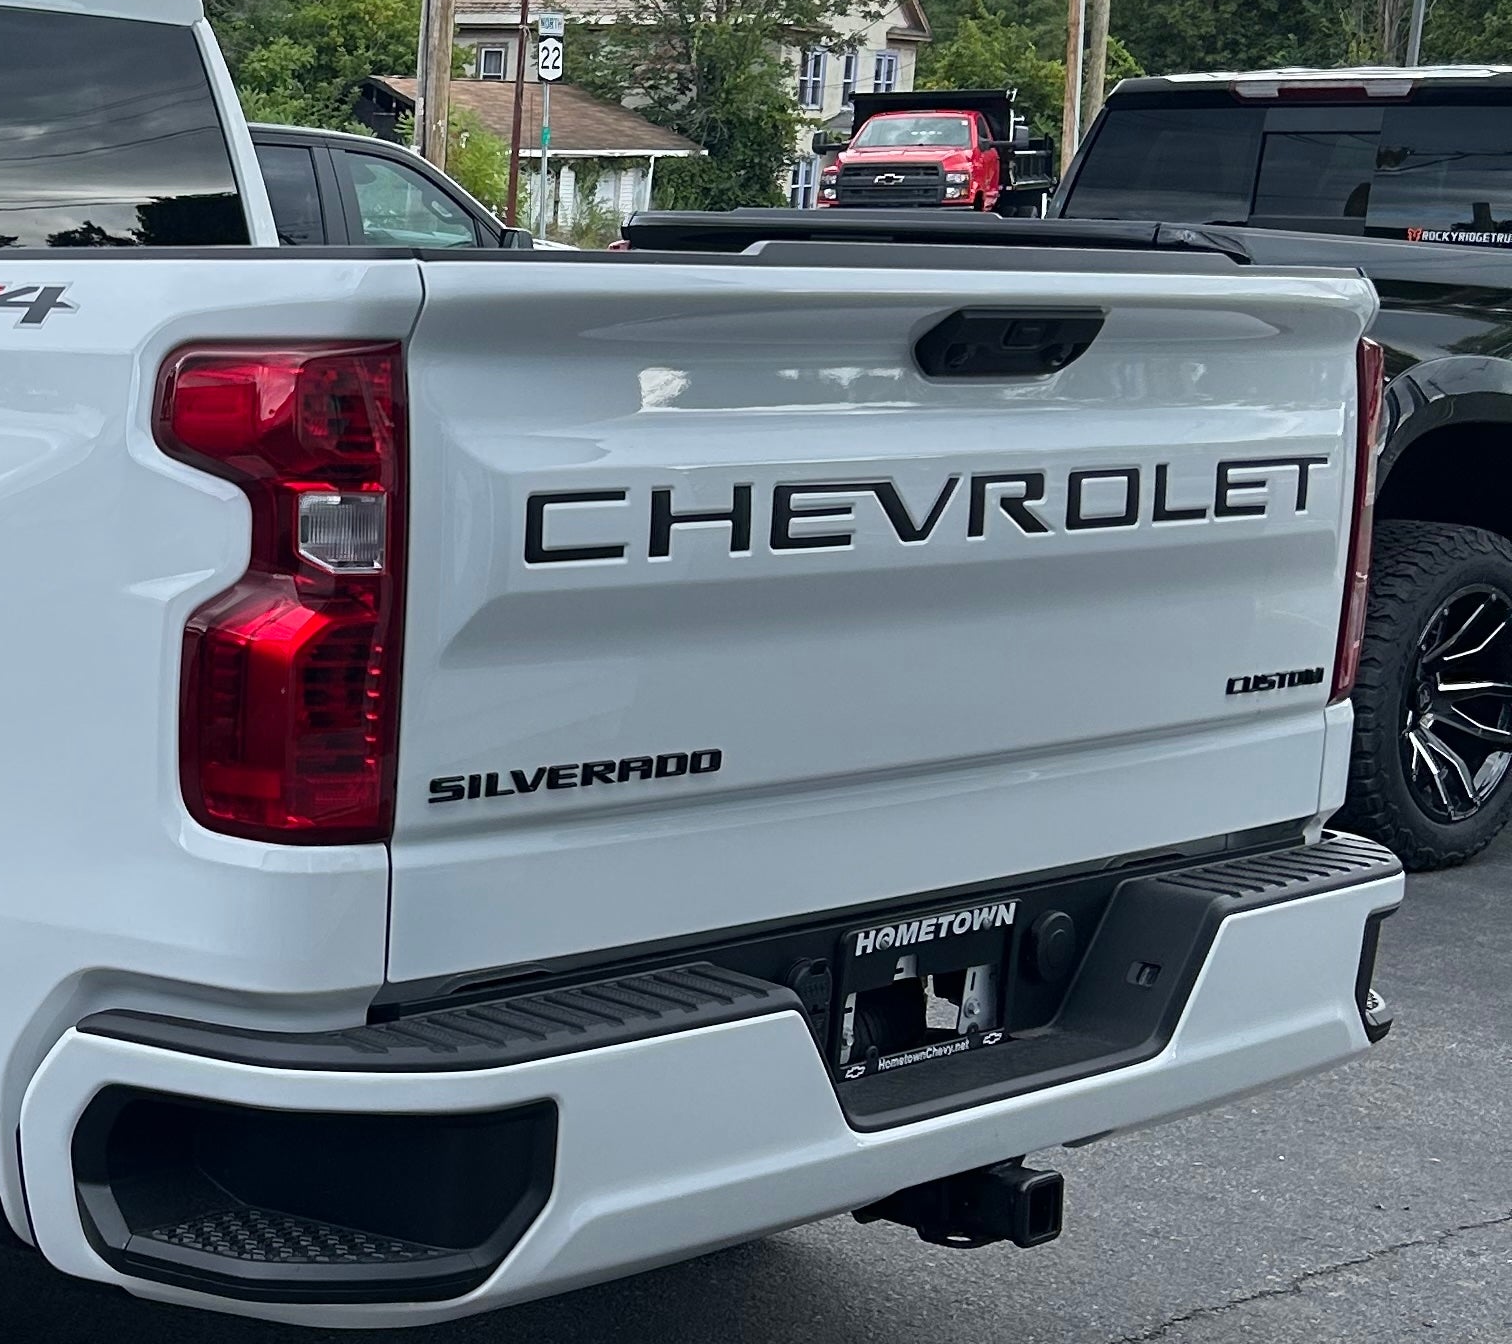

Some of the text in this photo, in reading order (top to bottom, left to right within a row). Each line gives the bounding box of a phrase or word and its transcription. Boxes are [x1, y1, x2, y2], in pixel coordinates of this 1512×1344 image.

[541, 46, 561, 70] 22
[525, 456, 1329, 564] CHEVROLET
[1225, 667, 1325, 695] CUSTOM
[428, 748, 722, 803] SILVERADO
[855, 902, 1017, 956] HOMETOWN
[877, 1037, 970, 1071] HometownChevy.net
